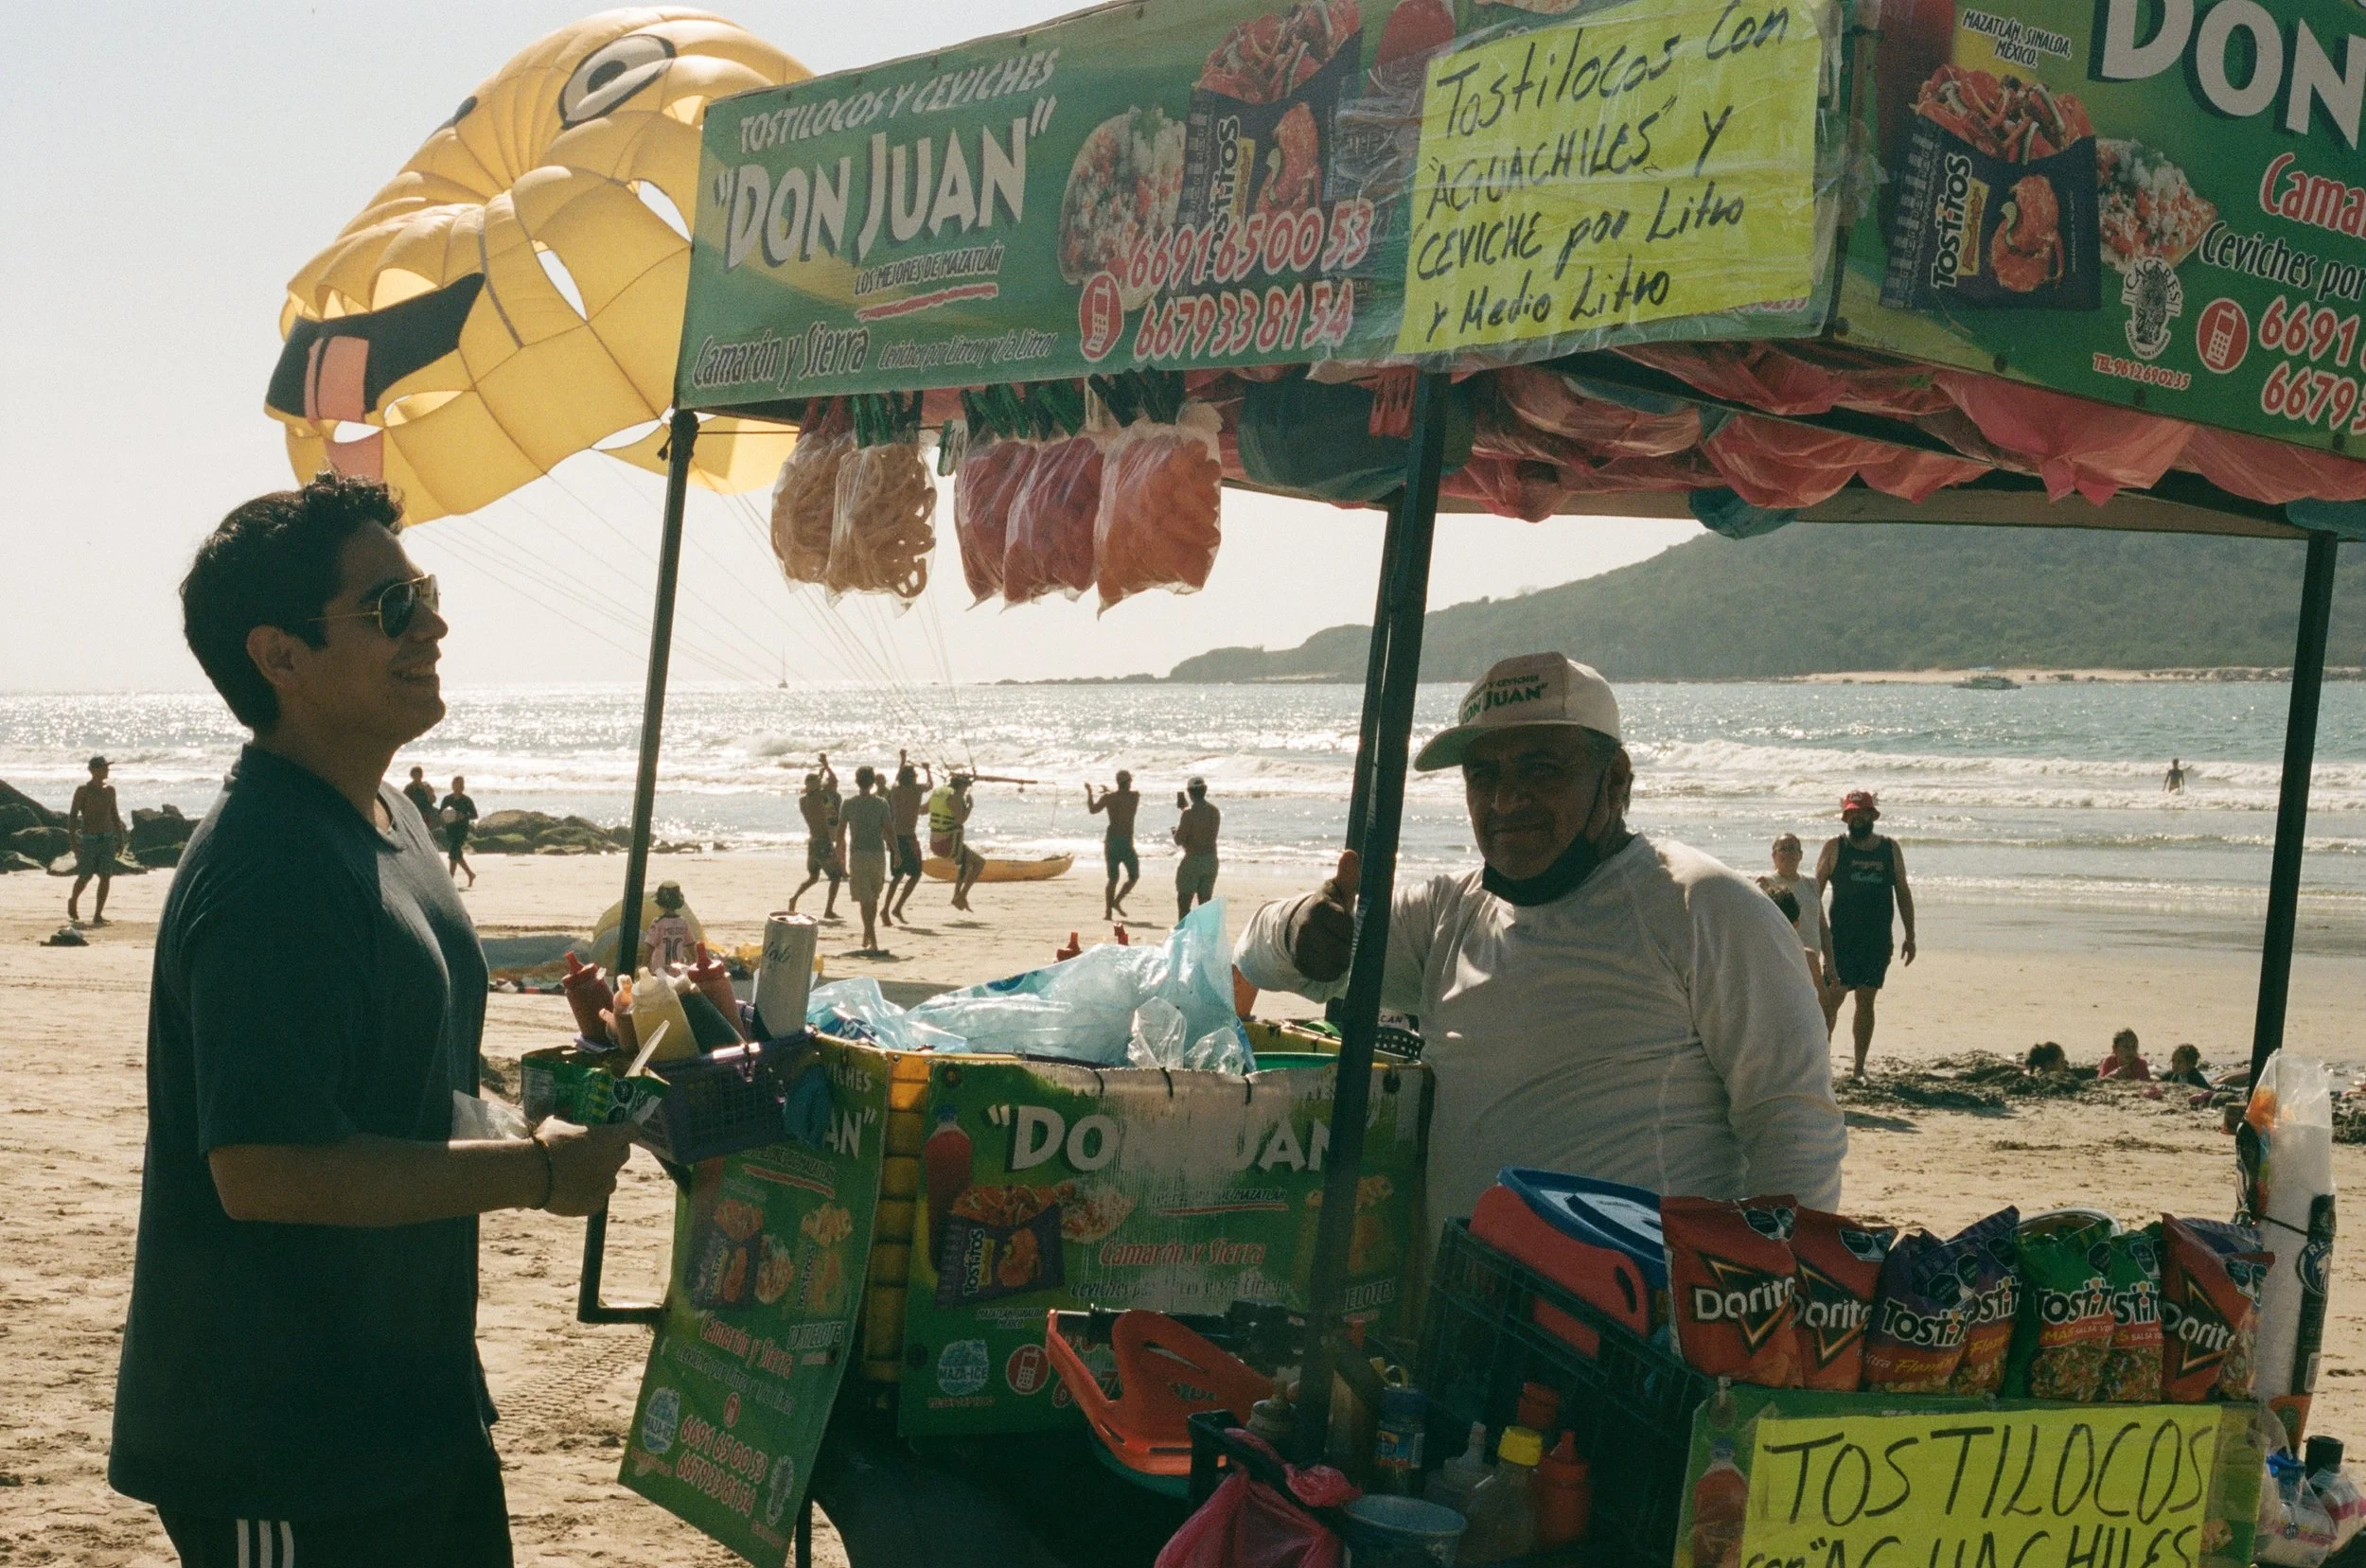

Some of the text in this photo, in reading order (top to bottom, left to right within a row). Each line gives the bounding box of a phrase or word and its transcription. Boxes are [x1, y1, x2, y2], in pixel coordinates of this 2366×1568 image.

[739, 47, 1061, 153] TOSTILOCOS Y CEVICHES
[715, 157, 852, 270] "DON
[856, 96, 1057, 262] JUAN"
[2259, 151, 2366, 239] Cama
[2198, 220, 2318, 290] Ceviches
[693, 321, 870, 392] Camarón y Sierra
[2258, 294, 2360, 368] 6691
